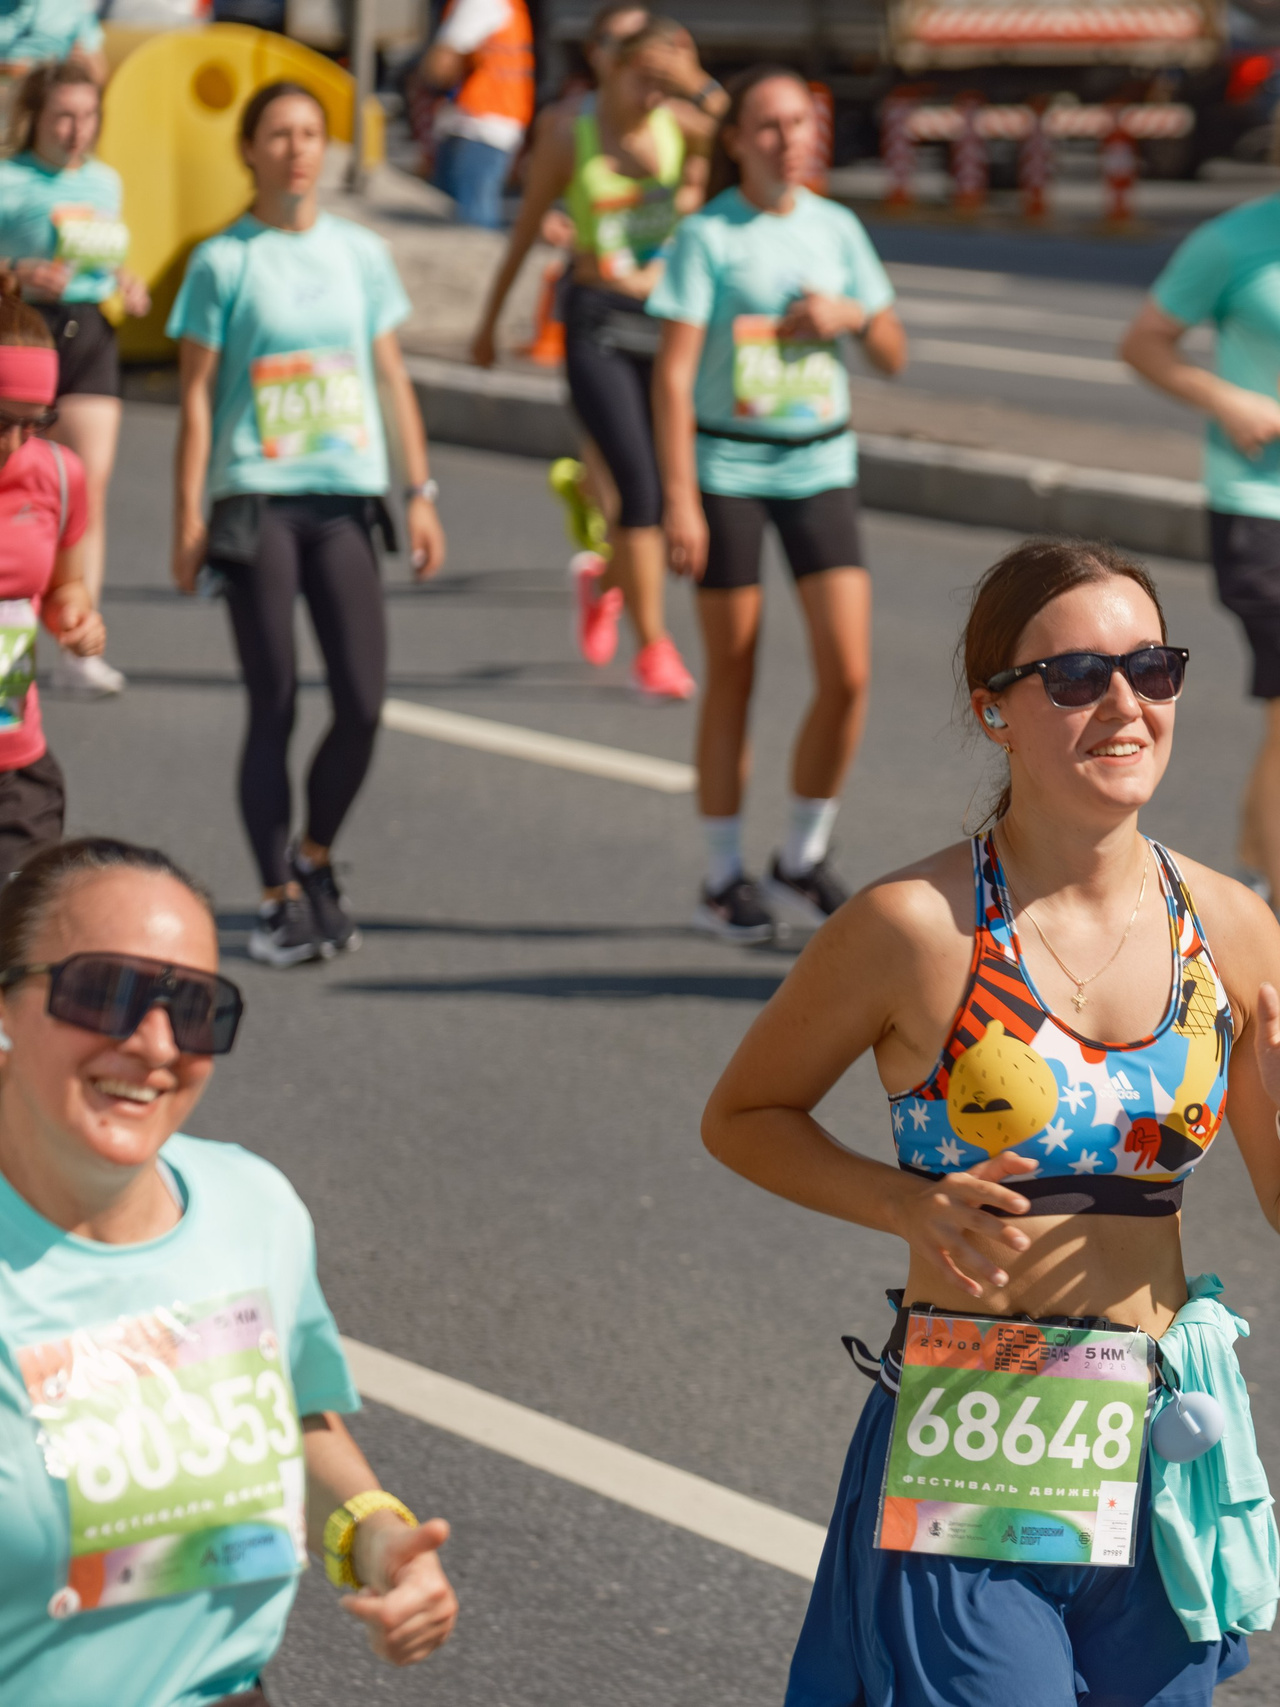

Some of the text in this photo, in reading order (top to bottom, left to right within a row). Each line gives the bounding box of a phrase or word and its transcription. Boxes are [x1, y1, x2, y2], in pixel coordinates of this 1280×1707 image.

[1099, 1084, 1140, 1100] adidas
[1085, 1347, 1097, 1360] 5
[1084, 1361, 1127, 1371] 2026
[906, 1387, 1134, 1470] 68648
[902, 1474, 1019, 1494] ФЕСТИВАЛЬ
